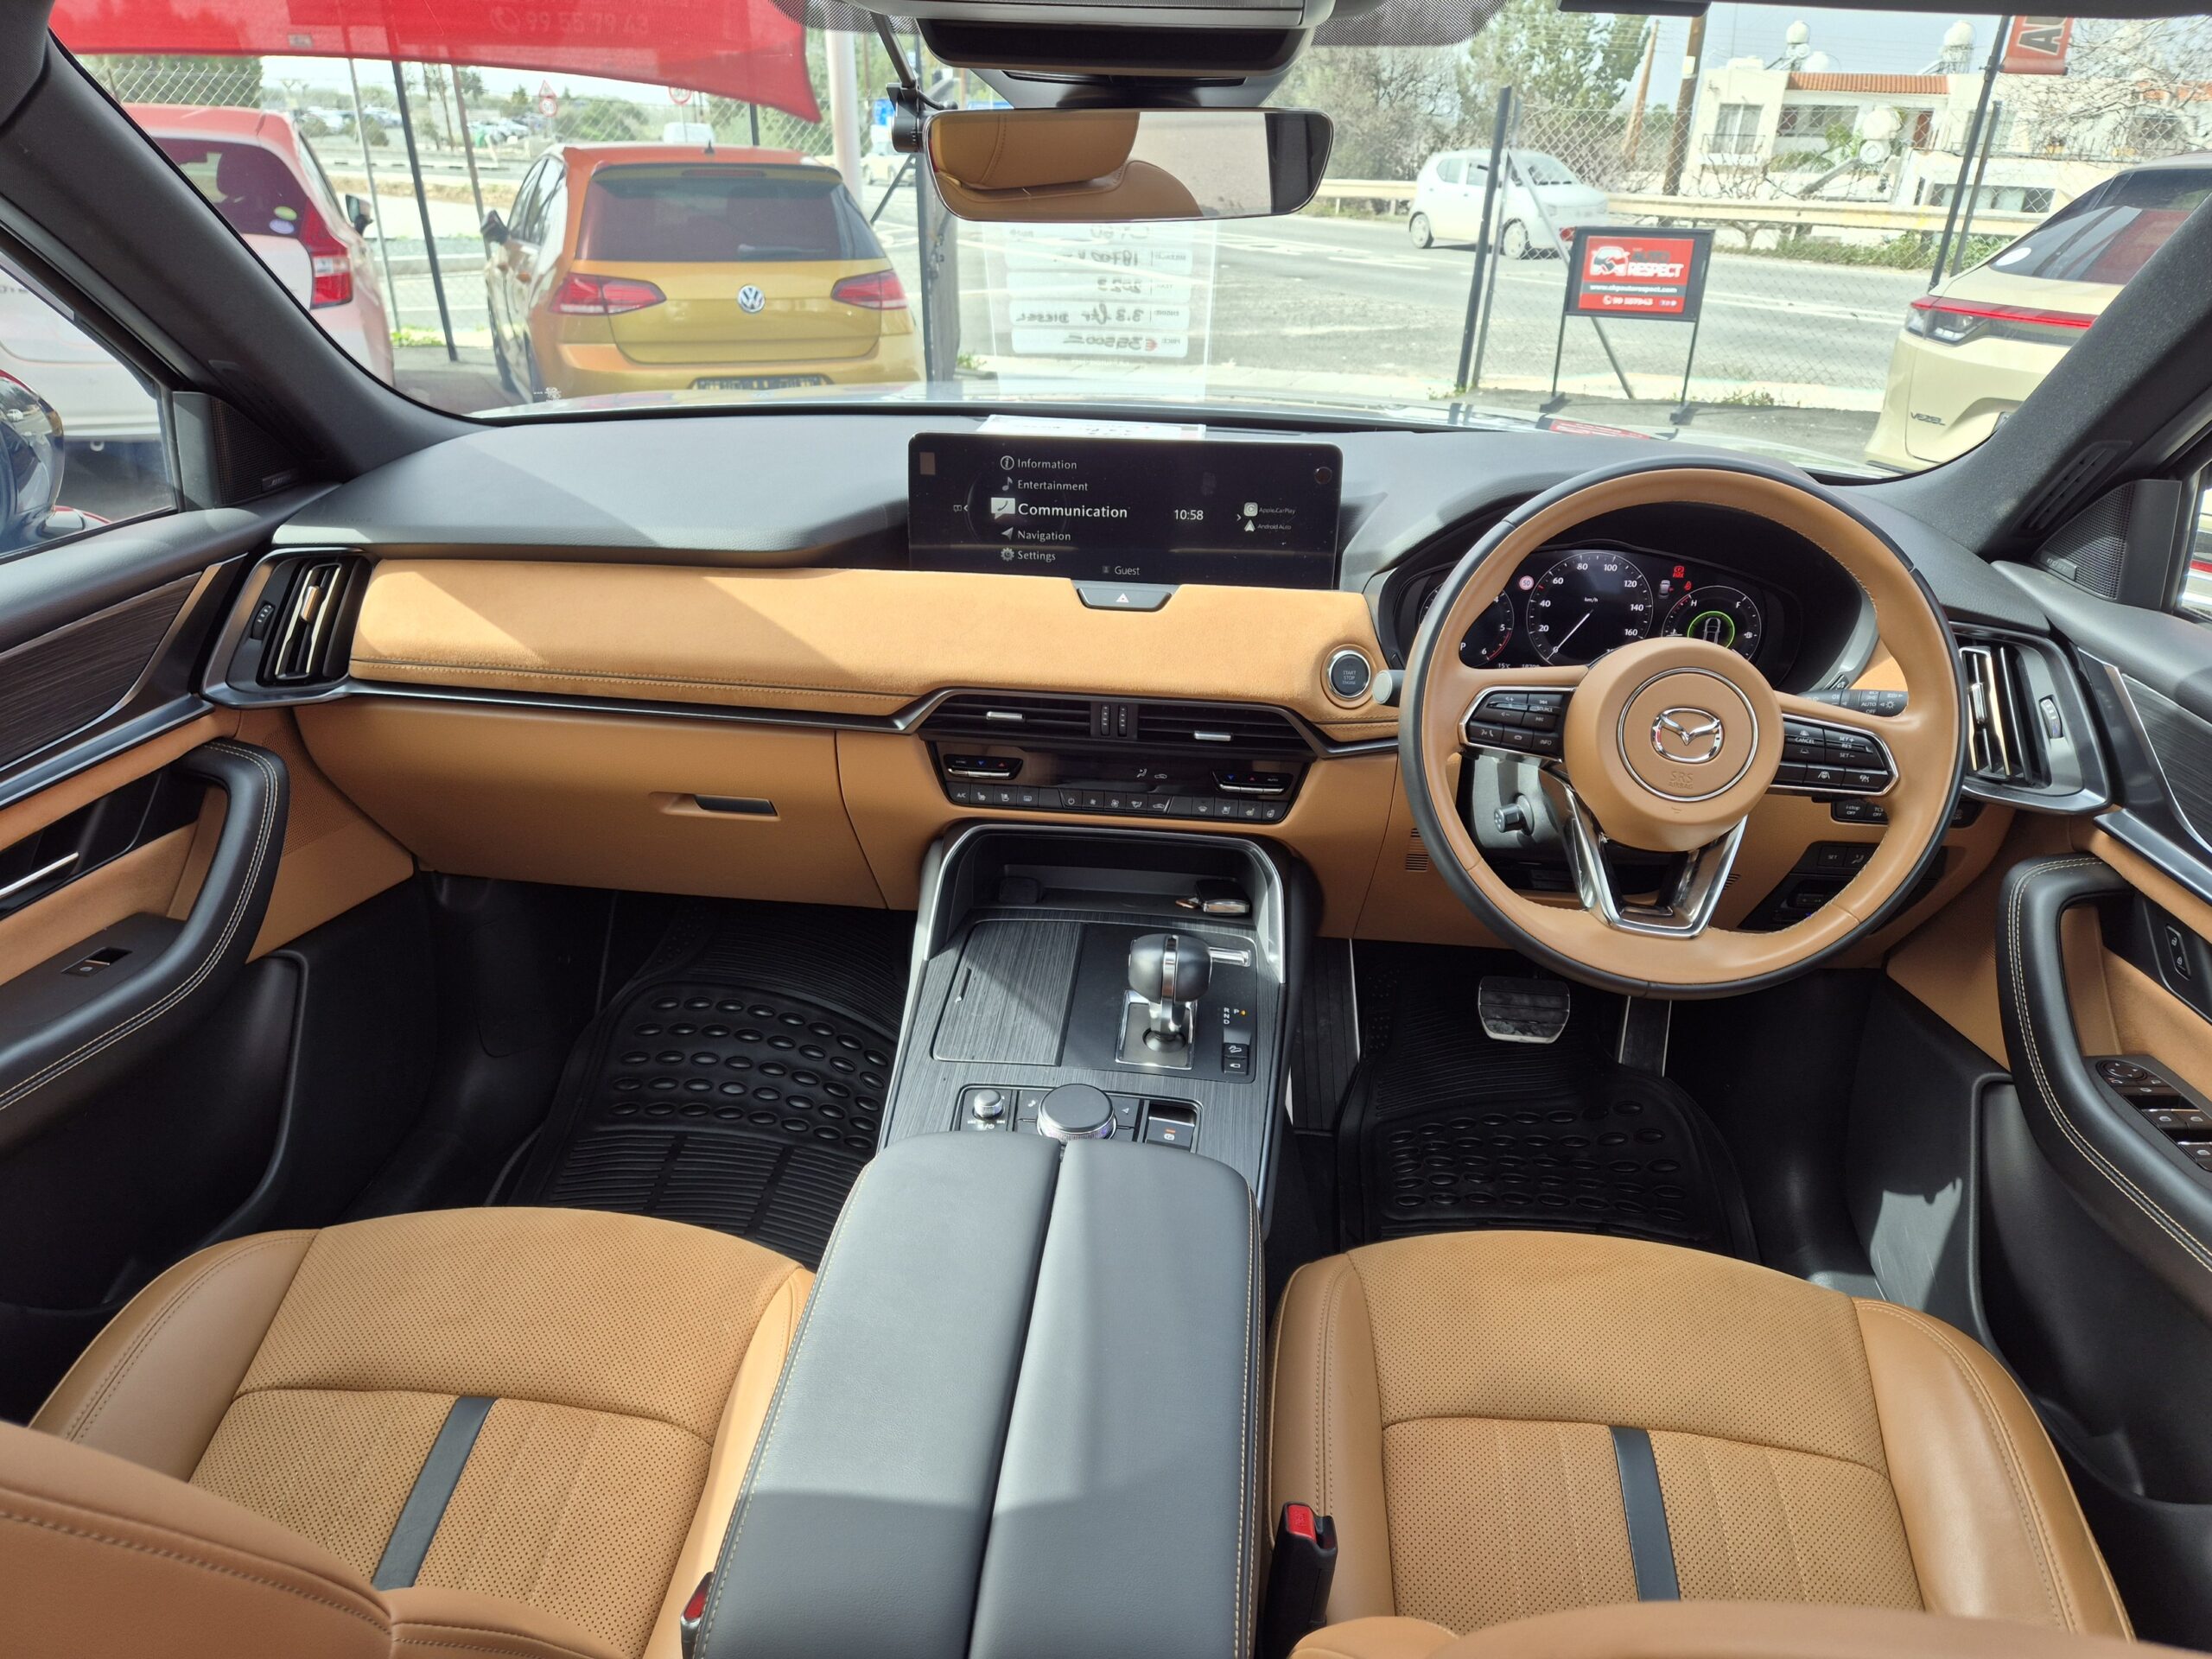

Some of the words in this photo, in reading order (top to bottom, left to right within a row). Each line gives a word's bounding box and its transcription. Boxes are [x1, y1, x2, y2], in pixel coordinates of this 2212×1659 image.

[1626, 262, 1684, 277] RESPECT
[1910, 411, 1946, 427] VEZEL
[1017, 457, 1077, 470] Information
[1017, 479, 1089, 492] Entertainment
[1018, 502, 1128, 518] Communication
[1173, 509, 1205, 522] 10:58
[1017, 531, 1071, 543] Navigation
[1017, 550, 1057, 563] Settings
[1114, 565, 1141, 576] Guest
[1552, 576, 1564, 585] 60
[1539, 599, 1551, 607] 40
[1630, 603, 1644, 612] 140
[1499, 623, 1506, 632] 5
[1538, 624, 1549, 632] 20
[1624, 628, 1638, 637] 160
[1459, 641, 1466, 651] P
[1670, 771, 1694, 784] SRS
